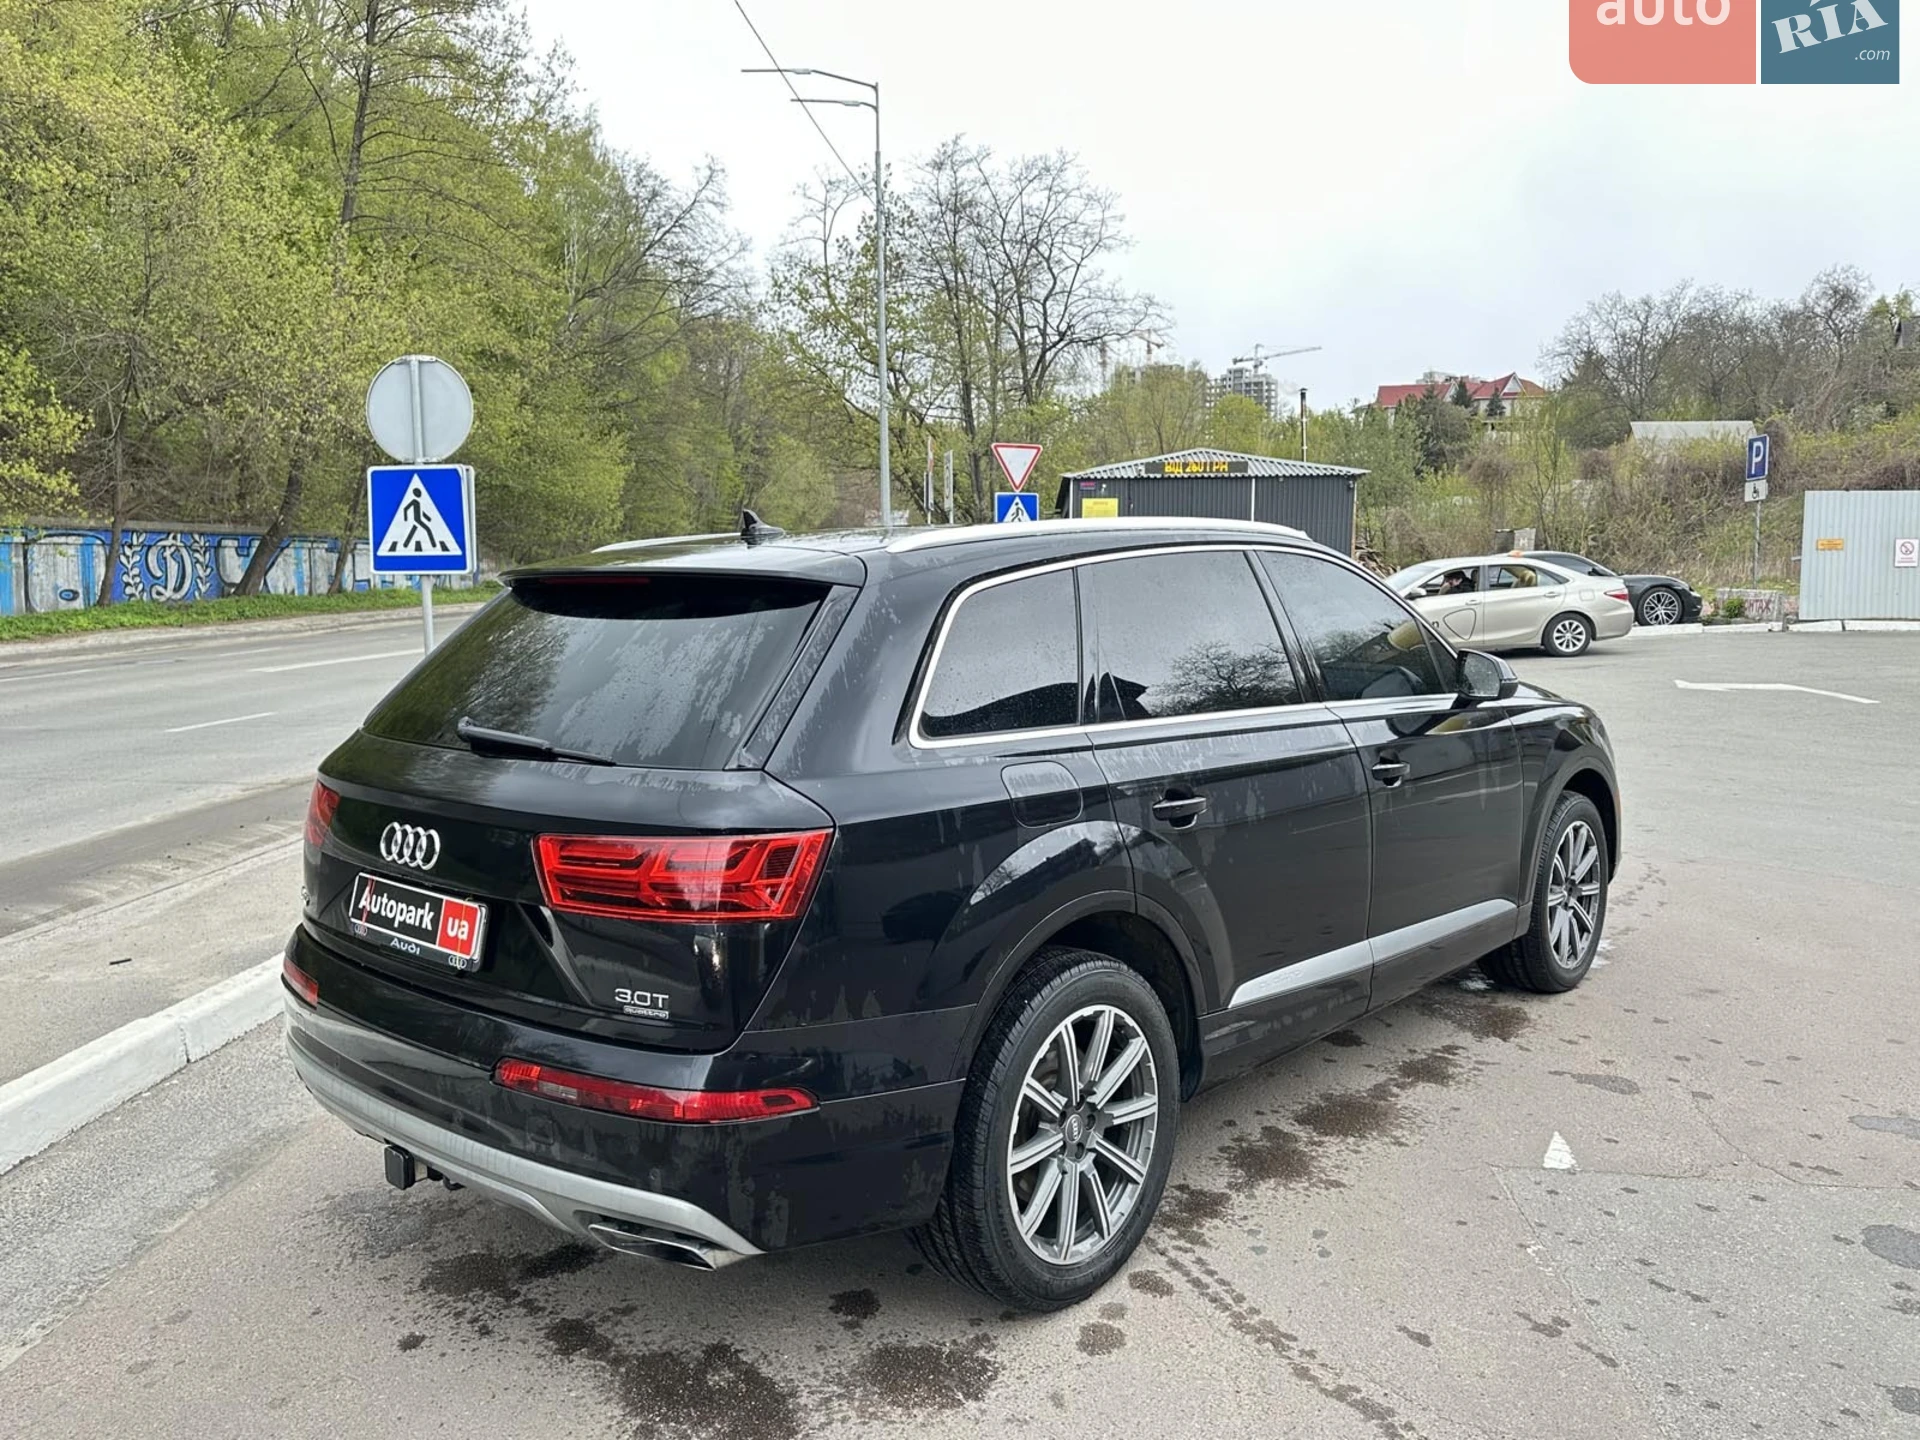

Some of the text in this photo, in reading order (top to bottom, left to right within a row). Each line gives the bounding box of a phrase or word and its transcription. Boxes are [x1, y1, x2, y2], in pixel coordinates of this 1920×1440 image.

[1751, 440, 1764, 475] P
[358, 886, 469, 941] Autopark ua
[390, 937, 421, 956] Audi
[614, 988, 669, 1009] 3.0T
